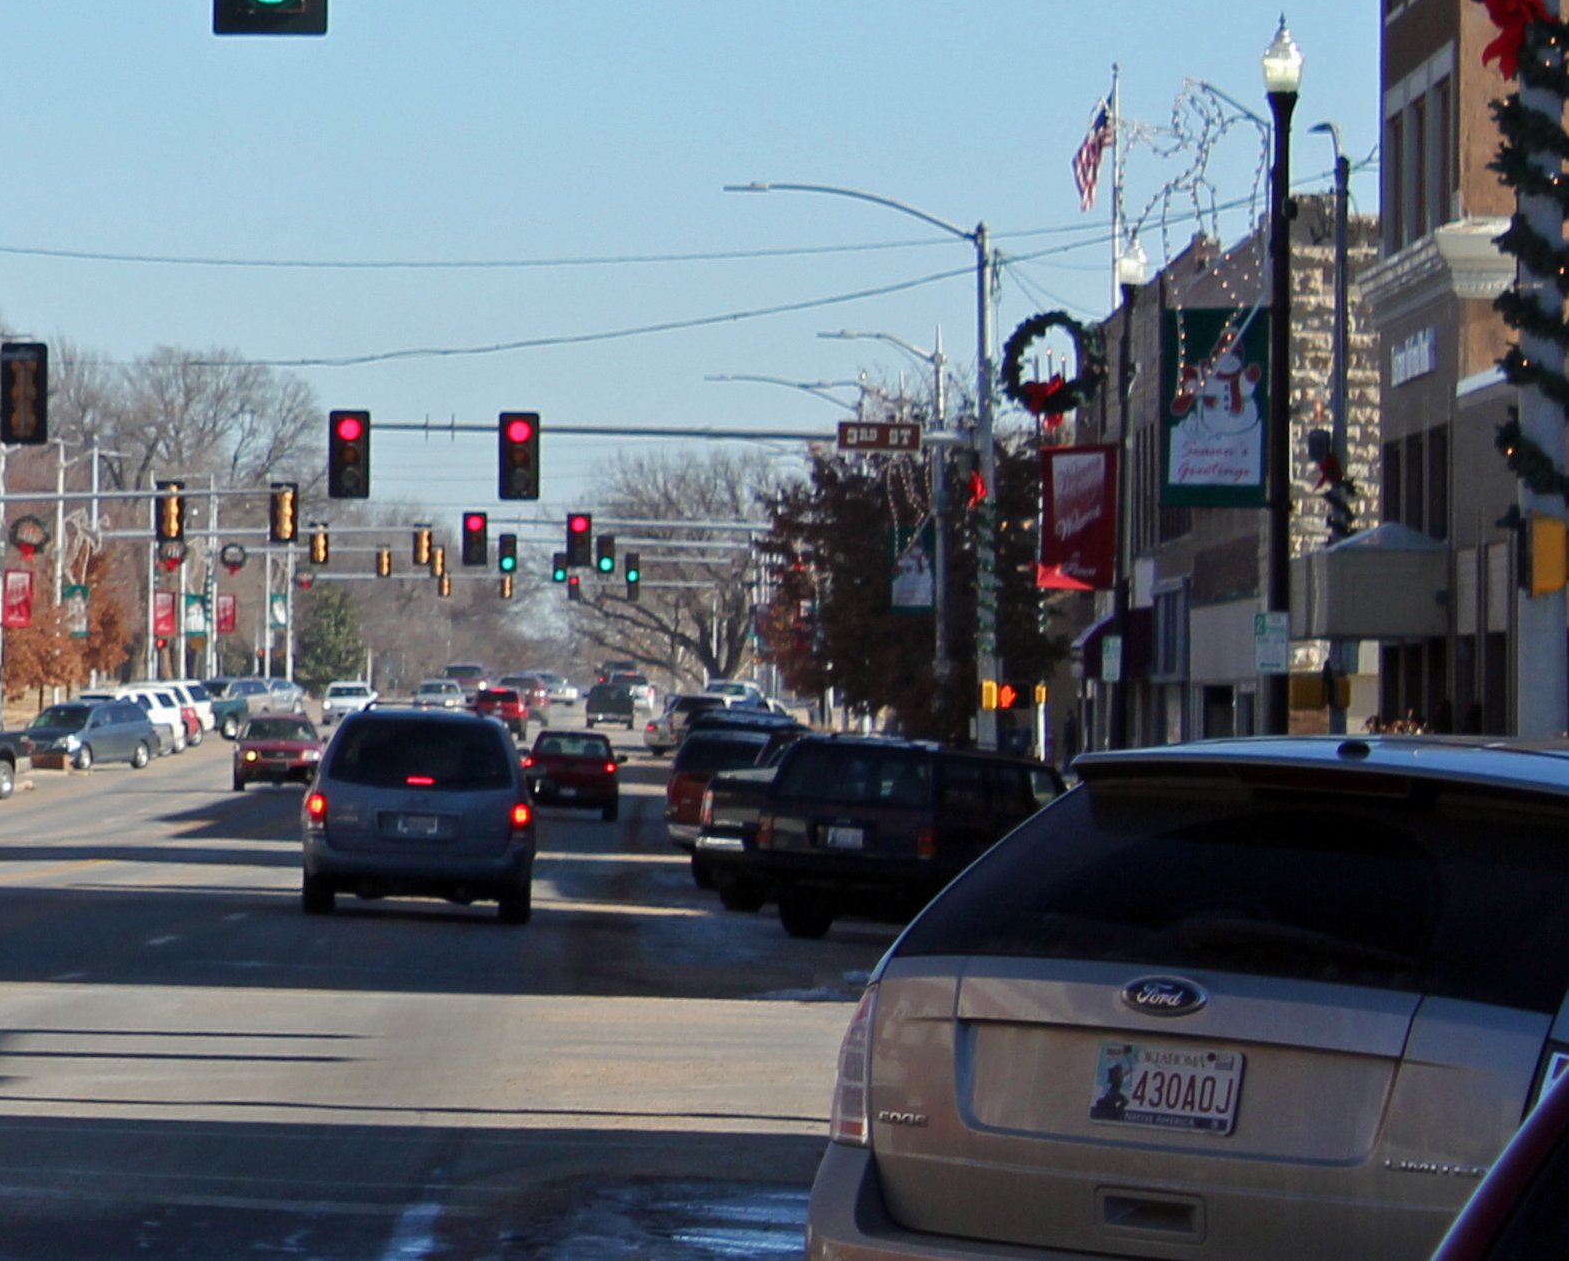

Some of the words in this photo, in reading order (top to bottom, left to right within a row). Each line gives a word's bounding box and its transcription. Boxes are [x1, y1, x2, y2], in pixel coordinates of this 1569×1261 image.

[846, 426, 878, 445] 3RD
[888, 427, 912, 446] ST
[1135, 983, 1184, 1007] Ford
[1135, 1050, 1206, 1068] OKLAHOMA
[878, 1110, 929, 1127] EDGE
[1124, 1112, 1154, 1124] NATIVE
[1156, 1114, 1195, 1126] AMERICA
